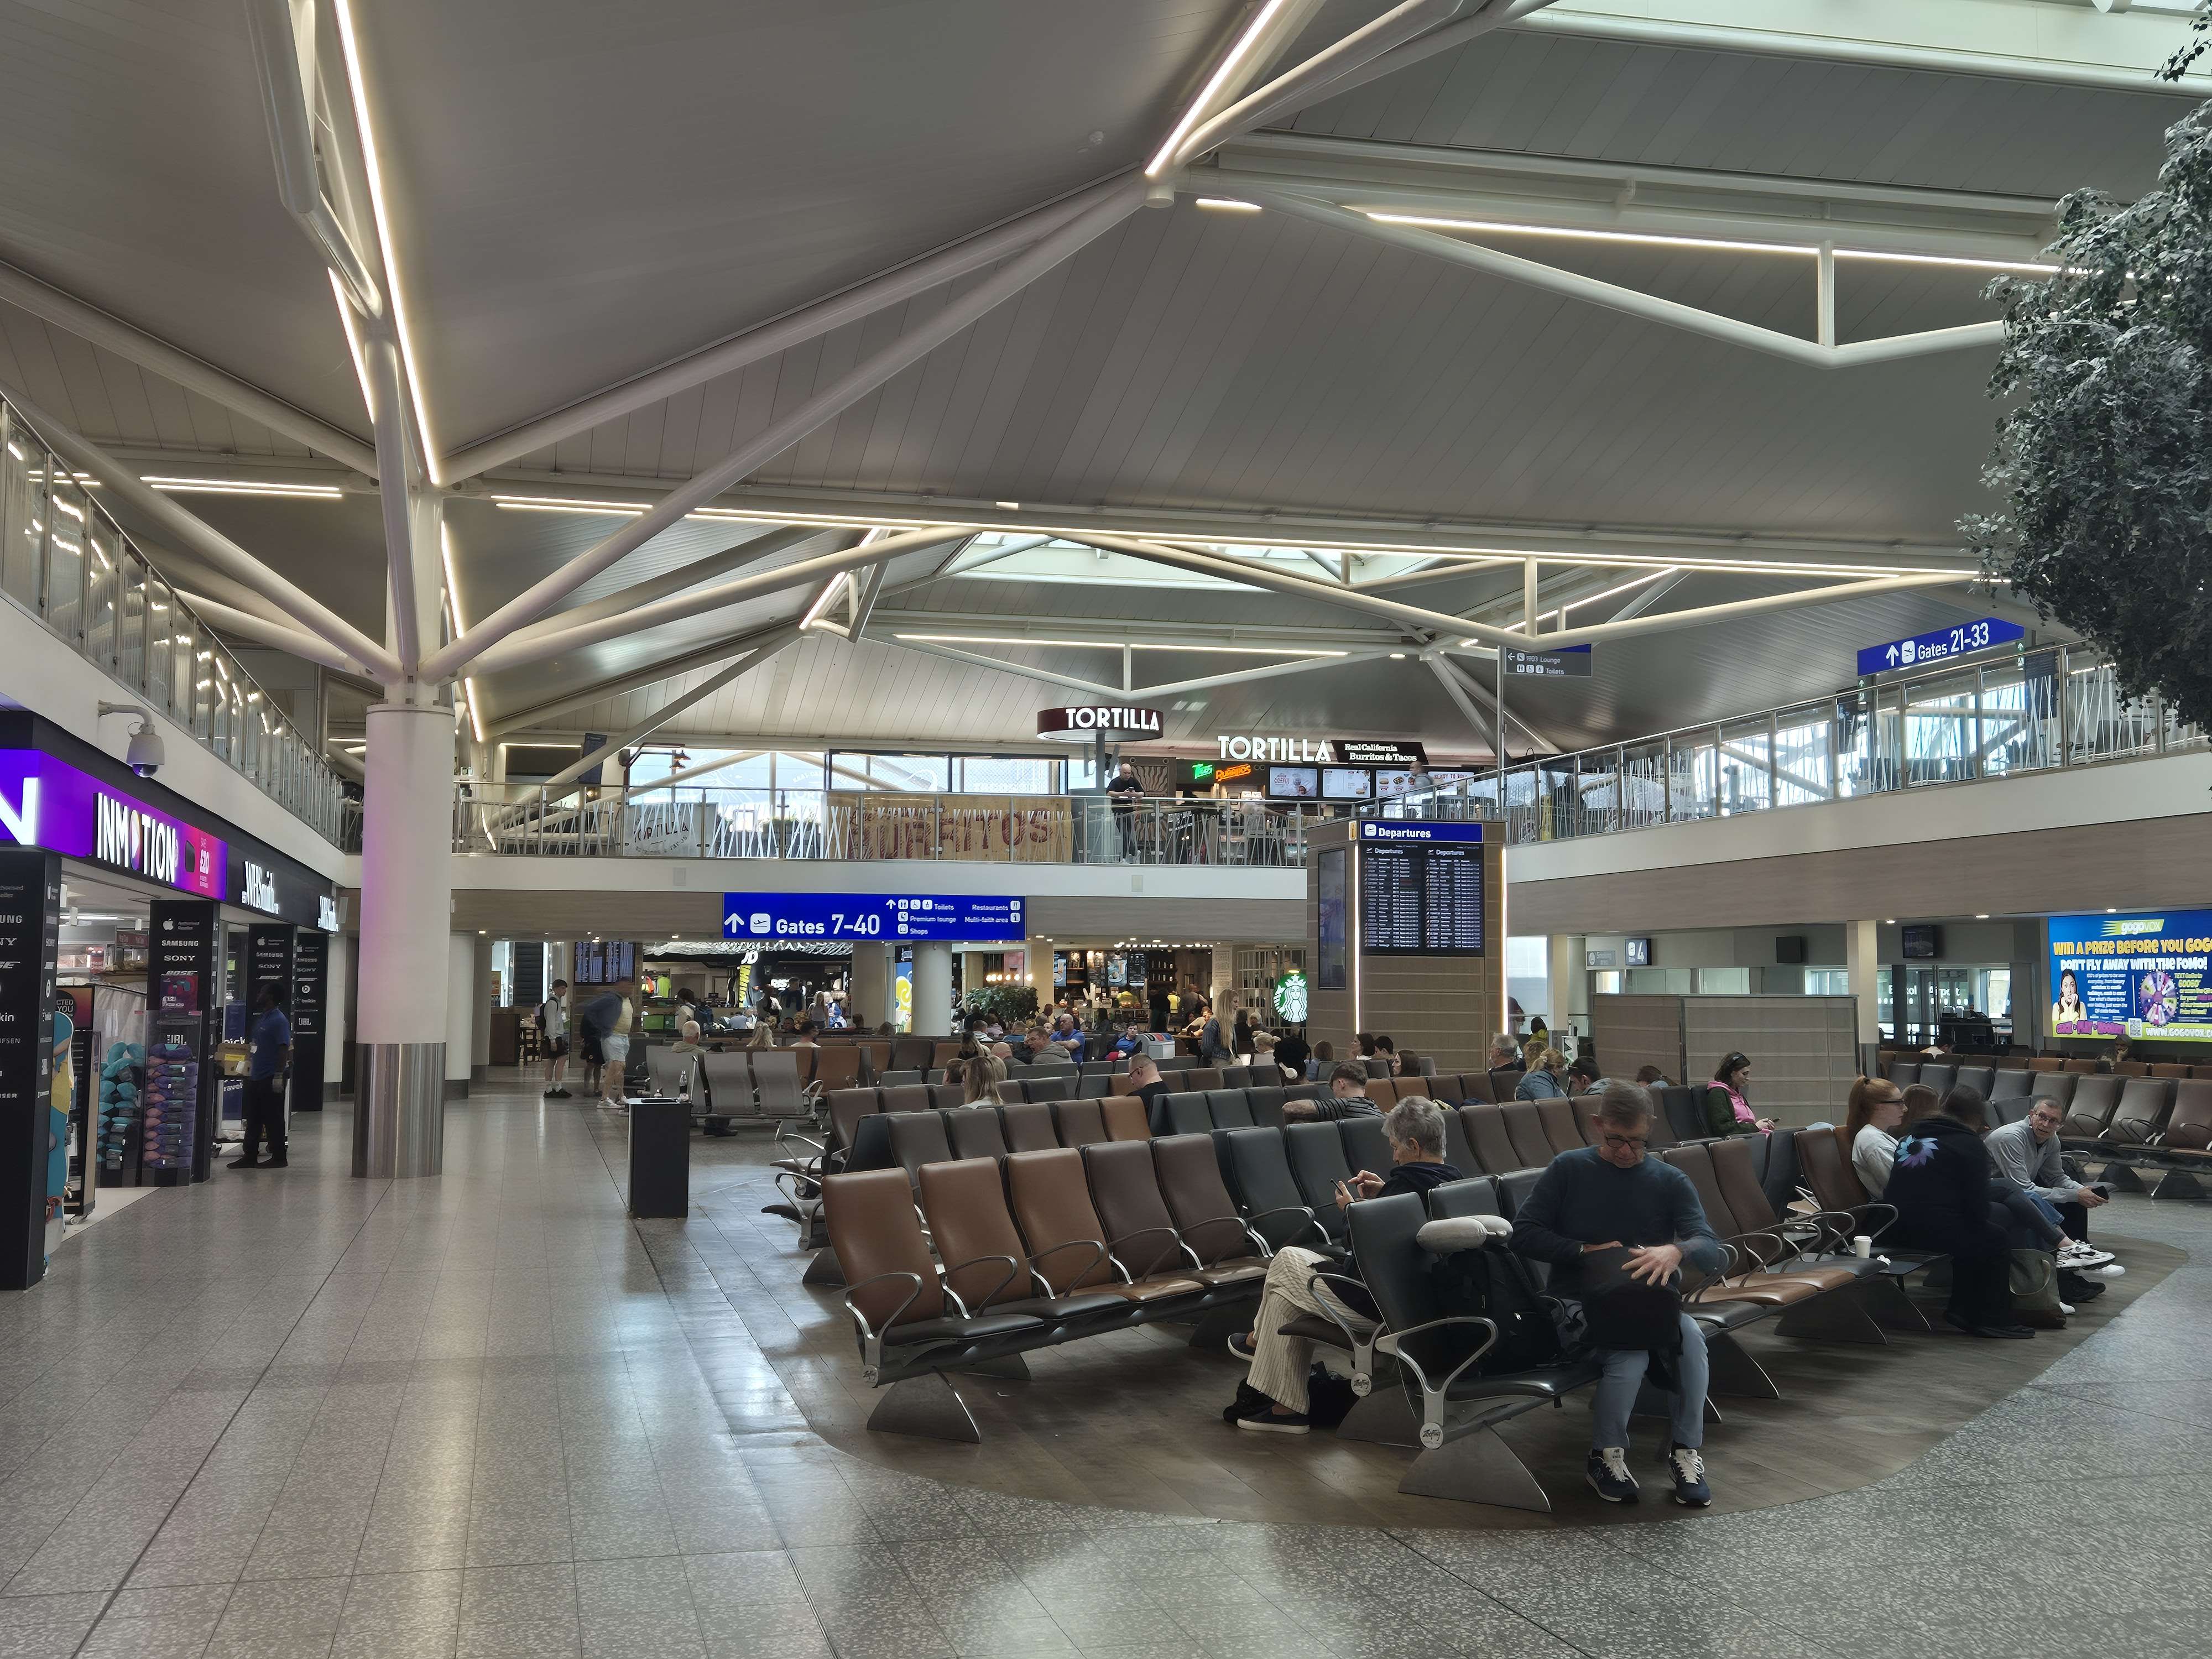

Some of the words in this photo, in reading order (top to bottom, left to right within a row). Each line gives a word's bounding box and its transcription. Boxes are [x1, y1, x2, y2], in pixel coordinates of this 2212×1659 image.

[1918, 643, 1948, 660] Gates
[1950, 622, 1989, 653] 21-33
[1065, 707, 1160, 731] TORTILLA
[1217, 736, 1332, 762] TORTILLA
[1361, 743, 1398, 752] California
[1349, 752, 1384, 761] Burritos
[97, 792, 176, 883] INMOTION
[1379, 827, 1431, 839] Departures
[776, 919, 825, 935] Gates
[832, 914, 880, 935] 7-40
[2075, 942, 2084, 955] A
[2160, 939, 2184, 953] YOU
[741, 950, 759, 964] JD
[2086, 959, 2102, 971] FLY
[2103, 959, 2130, 971] AWAY
[2130, 958, 2156, 970] WITH
[2176, 956, 2208, 970] FOMO!
